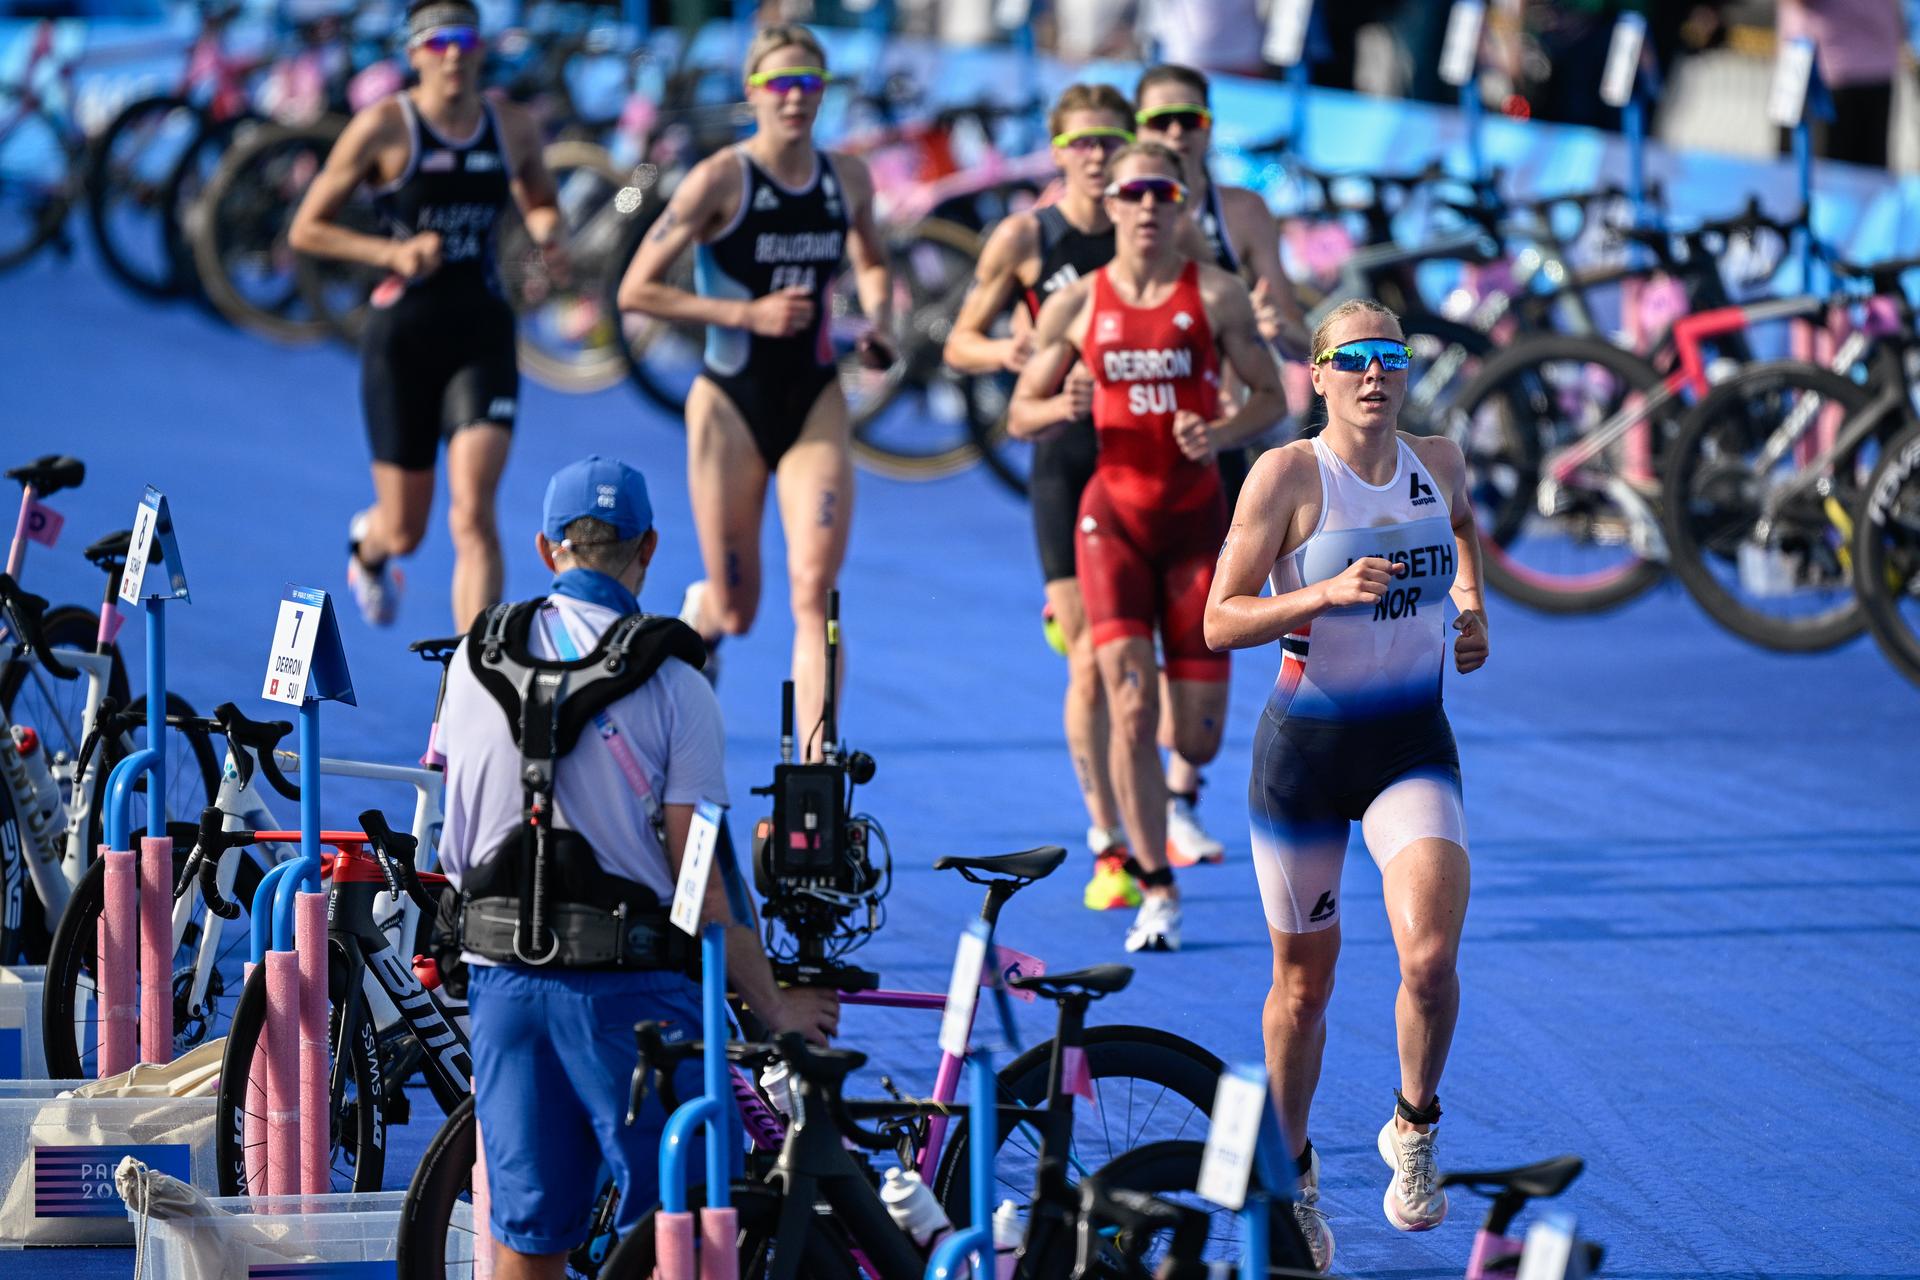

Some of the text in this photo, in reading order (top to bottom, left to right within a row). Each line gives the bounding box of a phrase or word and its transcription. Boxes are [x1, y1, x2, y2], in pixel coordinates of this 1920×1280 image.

[1103, 348, 1192, 381] DERRON
[1128, 383, 1177, 416] SUI
[138, 513, 148, 550] 8
[1373, 587, 1422, 622] NOR
[291, 610, 304, 648] 7
[275, 656, 302, 676] DERRON
[287, 682, 299, 700] SUI
[369, 945, 473, 1092] BMC
[362, 1022, 384, 1149] DT SWISS
